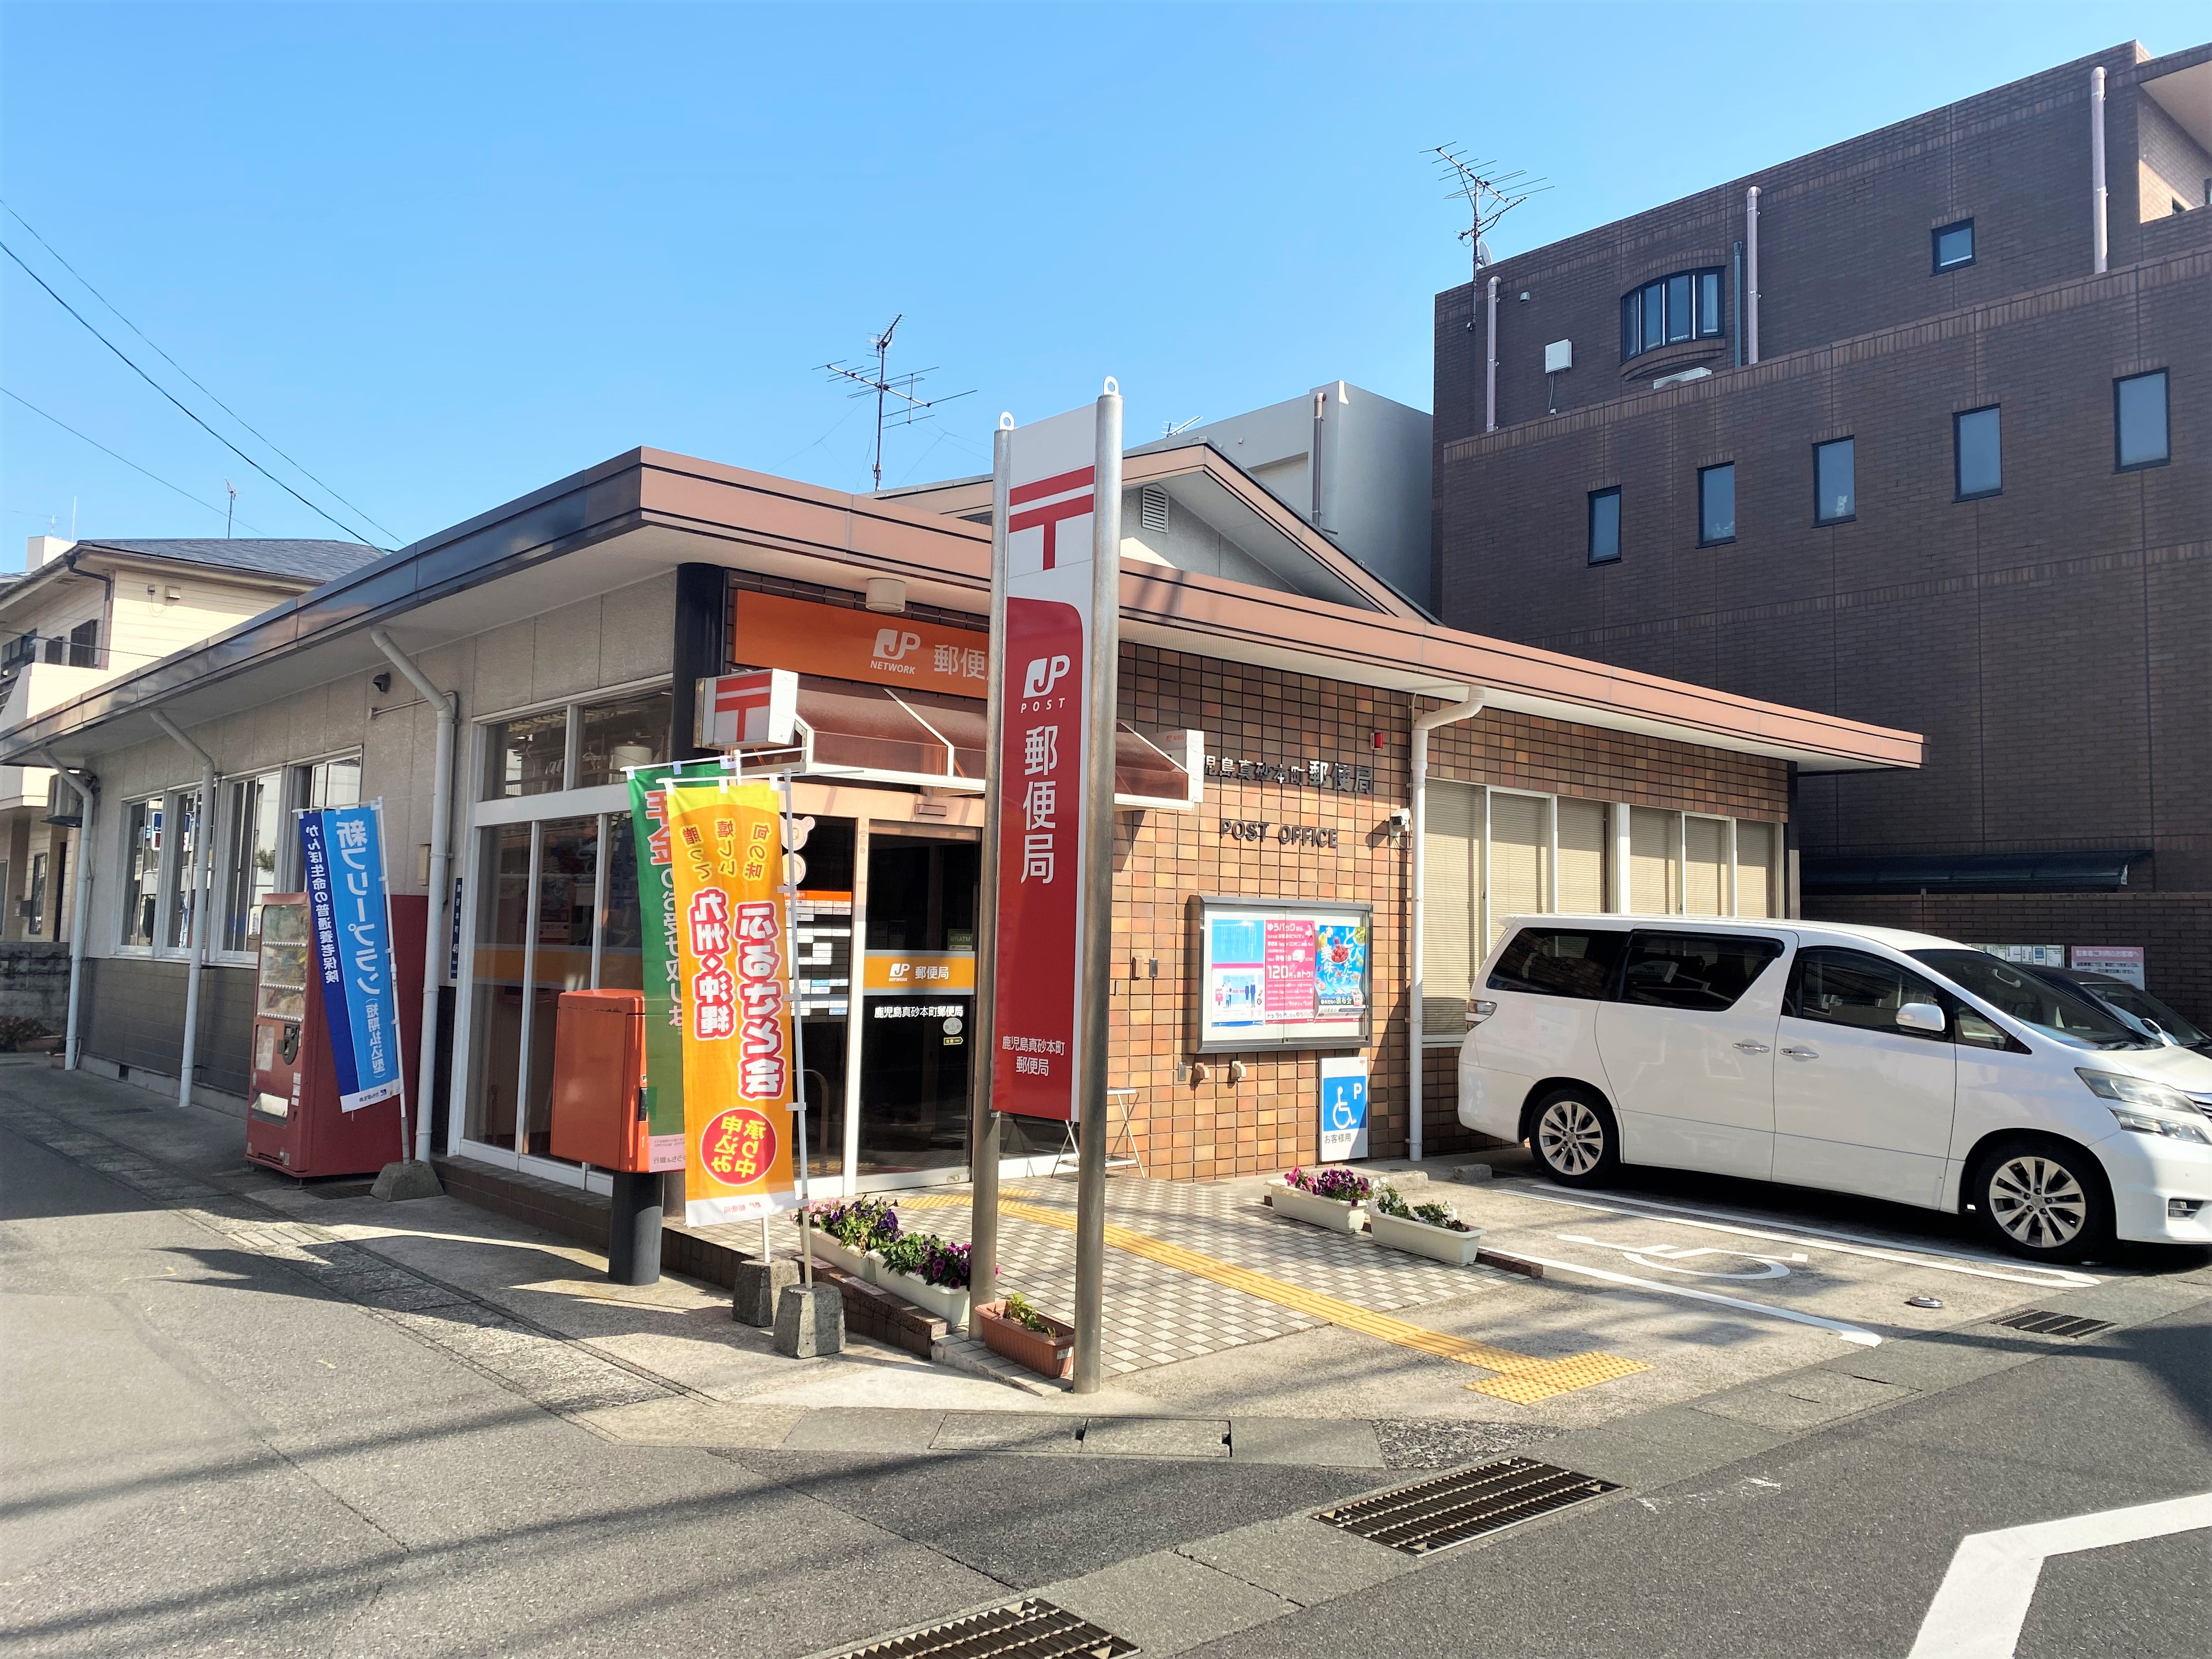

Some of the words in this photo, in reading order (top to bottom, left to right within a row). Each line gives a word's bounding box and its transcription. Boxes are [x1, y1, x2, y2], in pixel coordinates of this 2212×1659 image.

[870, 661, 916, 675] NETWORK
[934, 644, 989, 680] 郵便
[1020, 697, 1066, 713] POST
[1021, 725, 1058, 884] 郵便局
[1221, 819, 1269, 842] POST
[1278, 826, 1338, 848] OFFICE
[915, 966, 950, 980] 郵便局
[874, 1006, 963, 1018] 鹿児島真砂本町郵便局
[1002, 1035, 1065, 1056] 鹿児島真砂本町
[1016, 1056, 1048, 1076] 郵便局
[1353, 1083, 1362, 1099] P
[1324, 1133, 1351, 1144] お客様用
